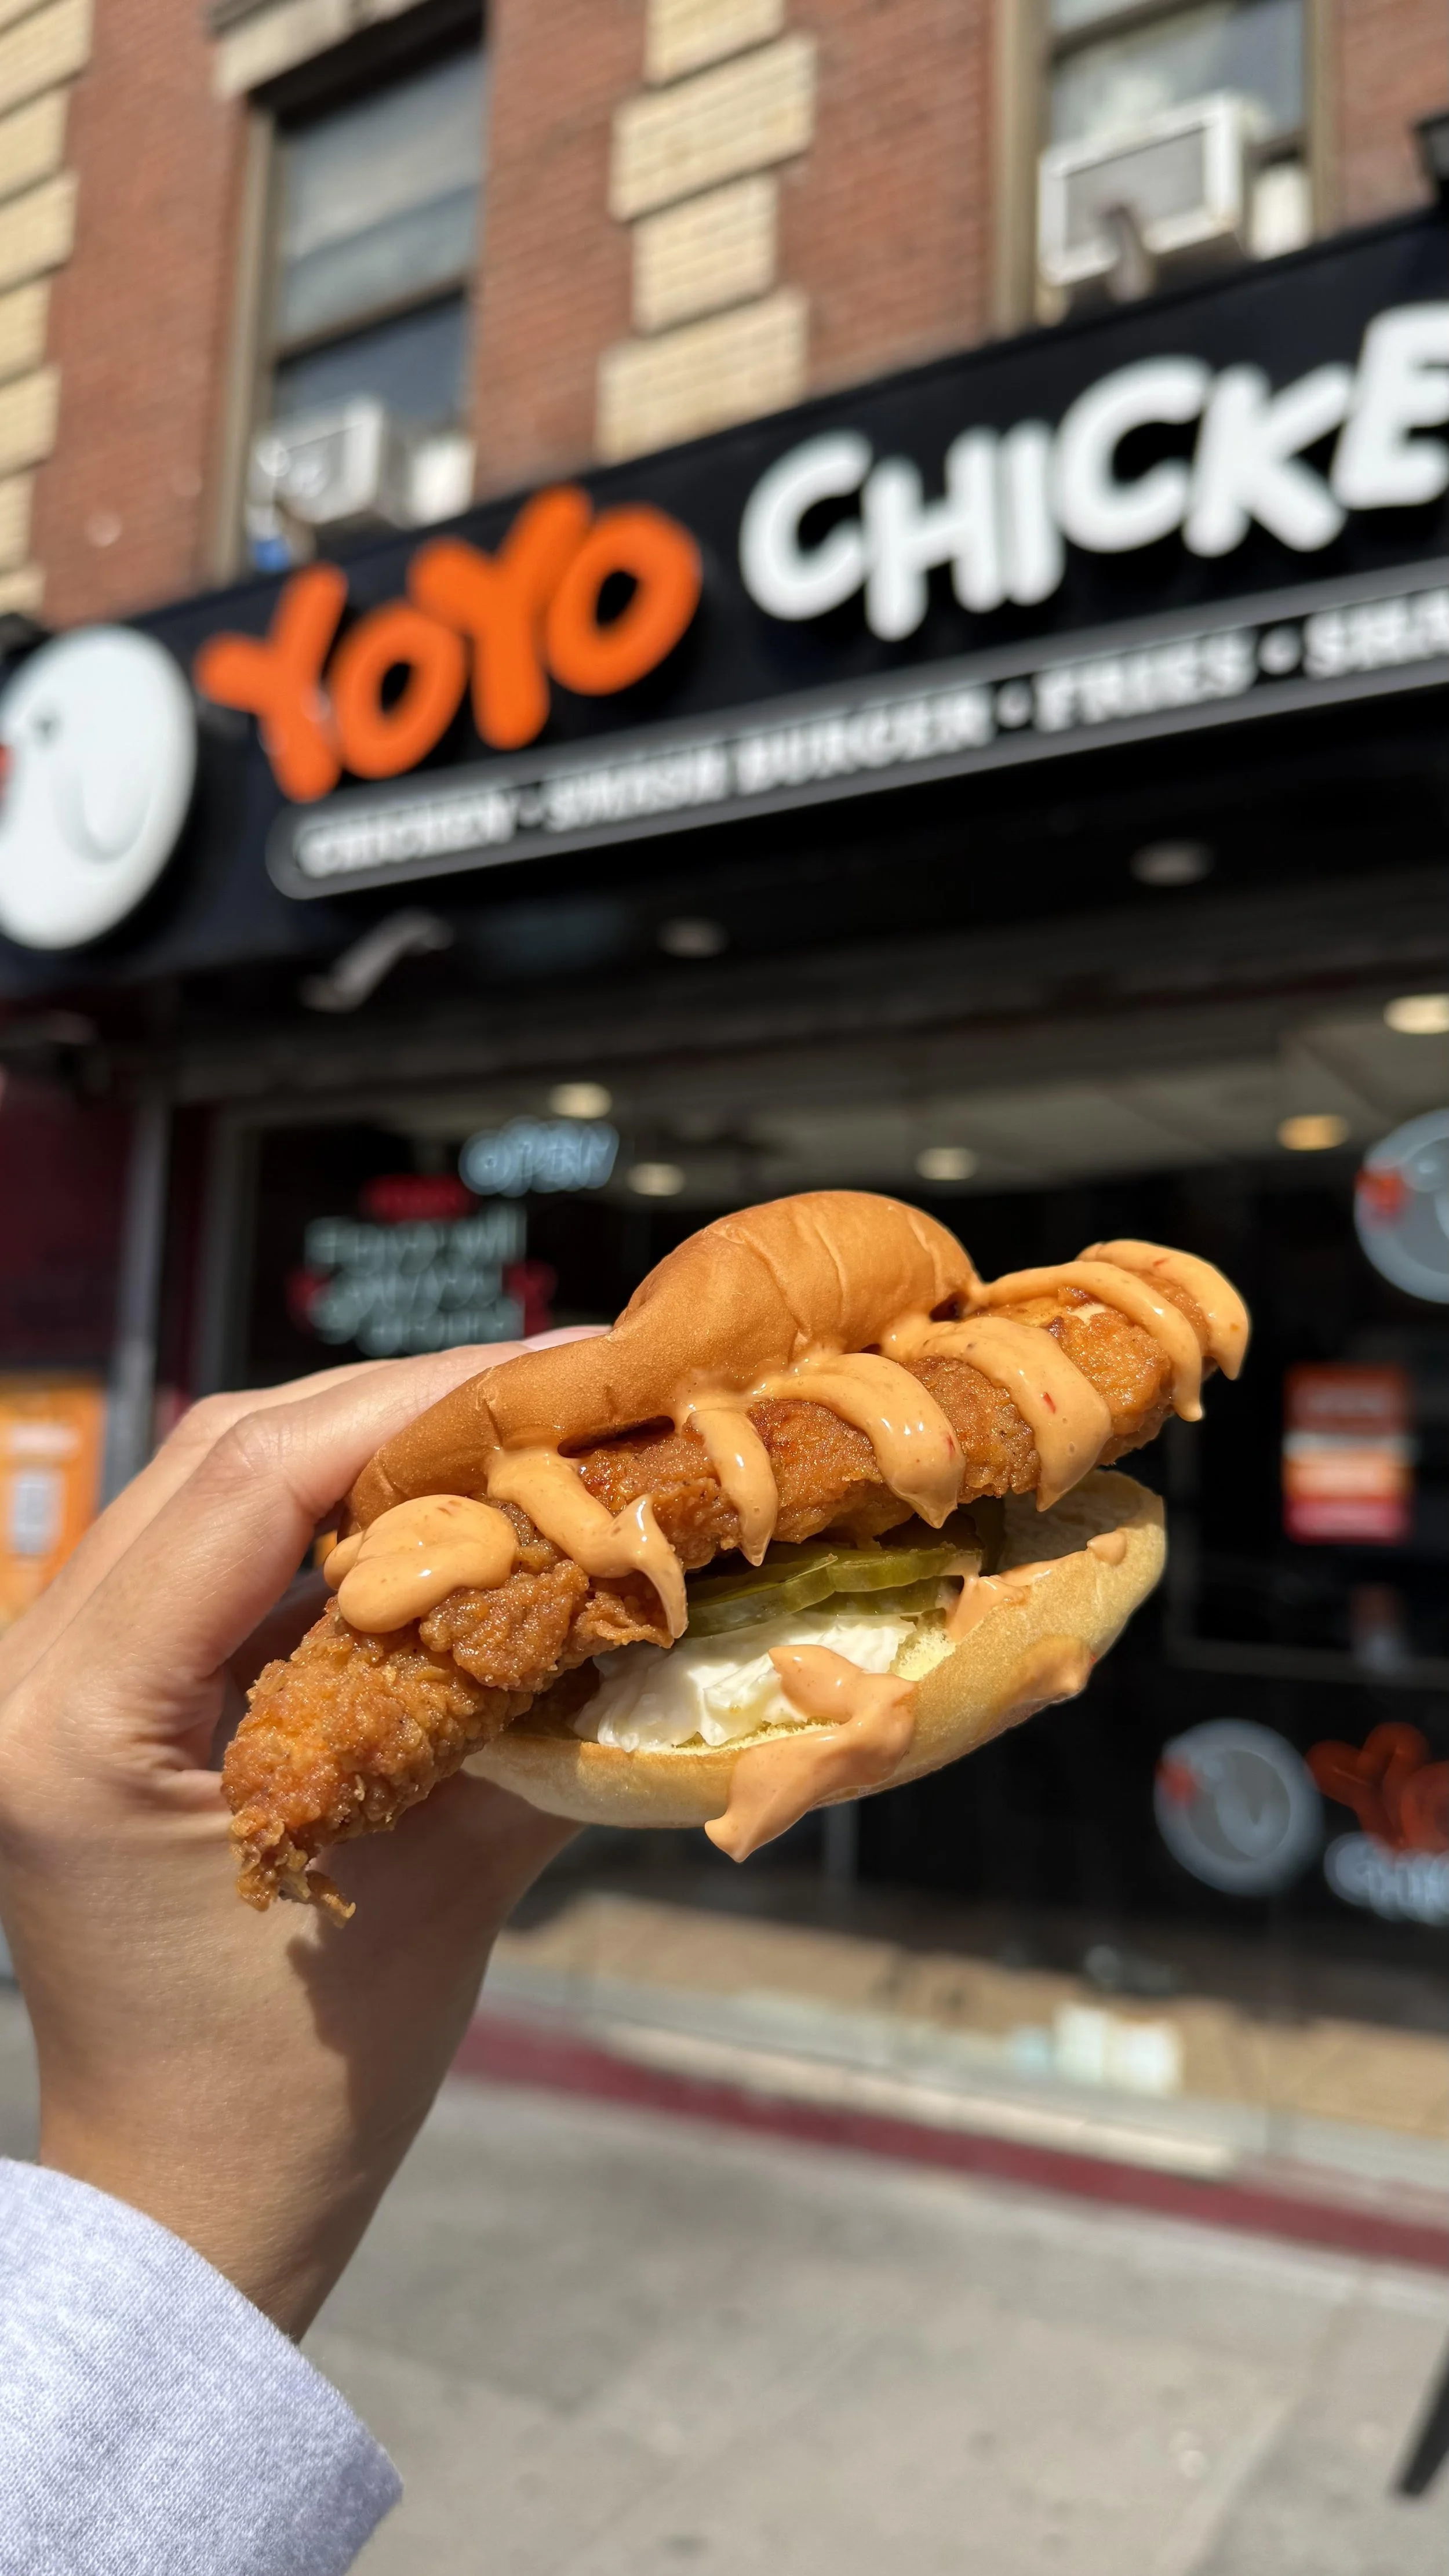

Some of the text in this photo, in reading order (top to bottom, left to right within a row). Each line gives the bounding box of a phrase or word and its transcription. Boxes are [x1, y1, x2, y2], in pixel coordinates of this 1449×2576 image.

[195, 300, 1449, 803] YOYO CHICKE
[735, 690, 995, 796] BURGER
[1033, 630, 1257, 733] FRIES
